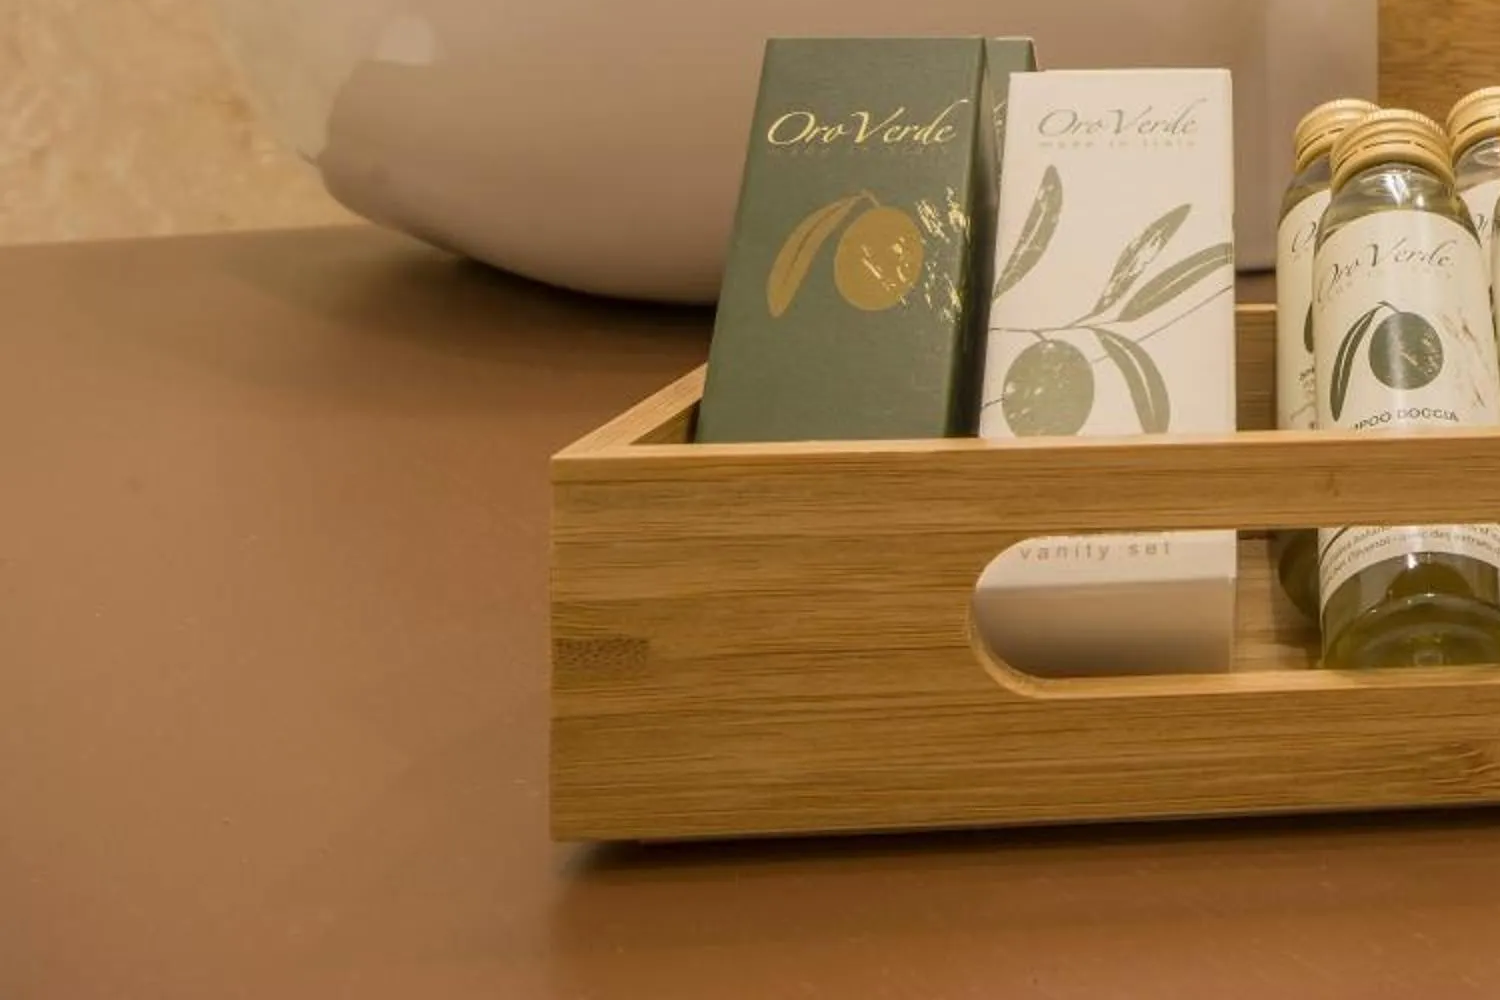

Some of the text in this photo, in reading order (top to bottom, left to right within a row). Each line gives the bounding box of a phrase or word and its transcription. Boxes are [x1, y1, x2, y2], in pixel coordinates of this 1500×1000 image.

[767, 111, 847, 146] Oro
[850, 99, 969, 146] Verde
[1038, 108, 1103, 137] Oro
[1105, 98, 1208, 136] Verde
[1366, 235, 1458, 269] Verde
[1397, 406, 1460, 422] DOCCIA
[1019, 540, 1171, 560] vanity set
